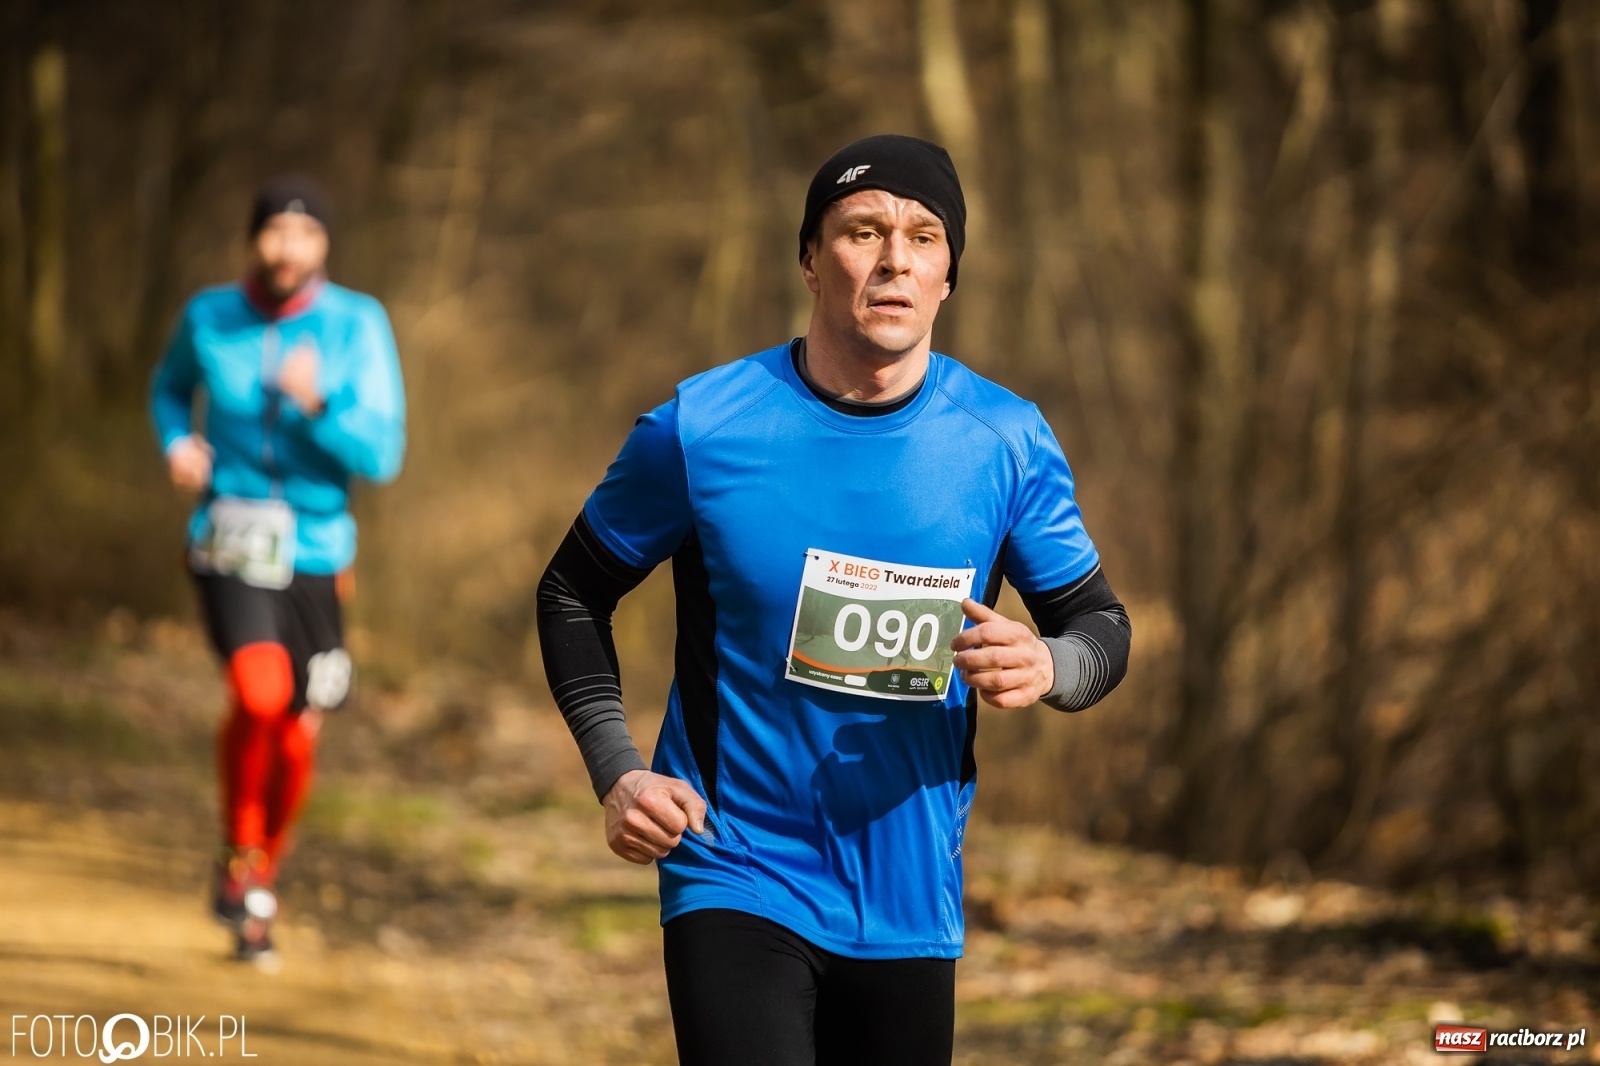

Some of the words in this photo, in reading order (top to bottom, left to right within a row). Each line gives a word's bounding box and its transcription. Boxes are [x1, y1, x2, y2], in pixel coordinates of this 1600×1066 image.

[836, 164, 871, 184] 4F
[828, 559, 840, 574] X
[843, 562, 880, 581] BIEG
[884, 569, 961, 589] Twardziela
[835, 578, 860, 588] lutego
[860, 582, 878, 592] 2022
[833, 603, 940, 661] 090
